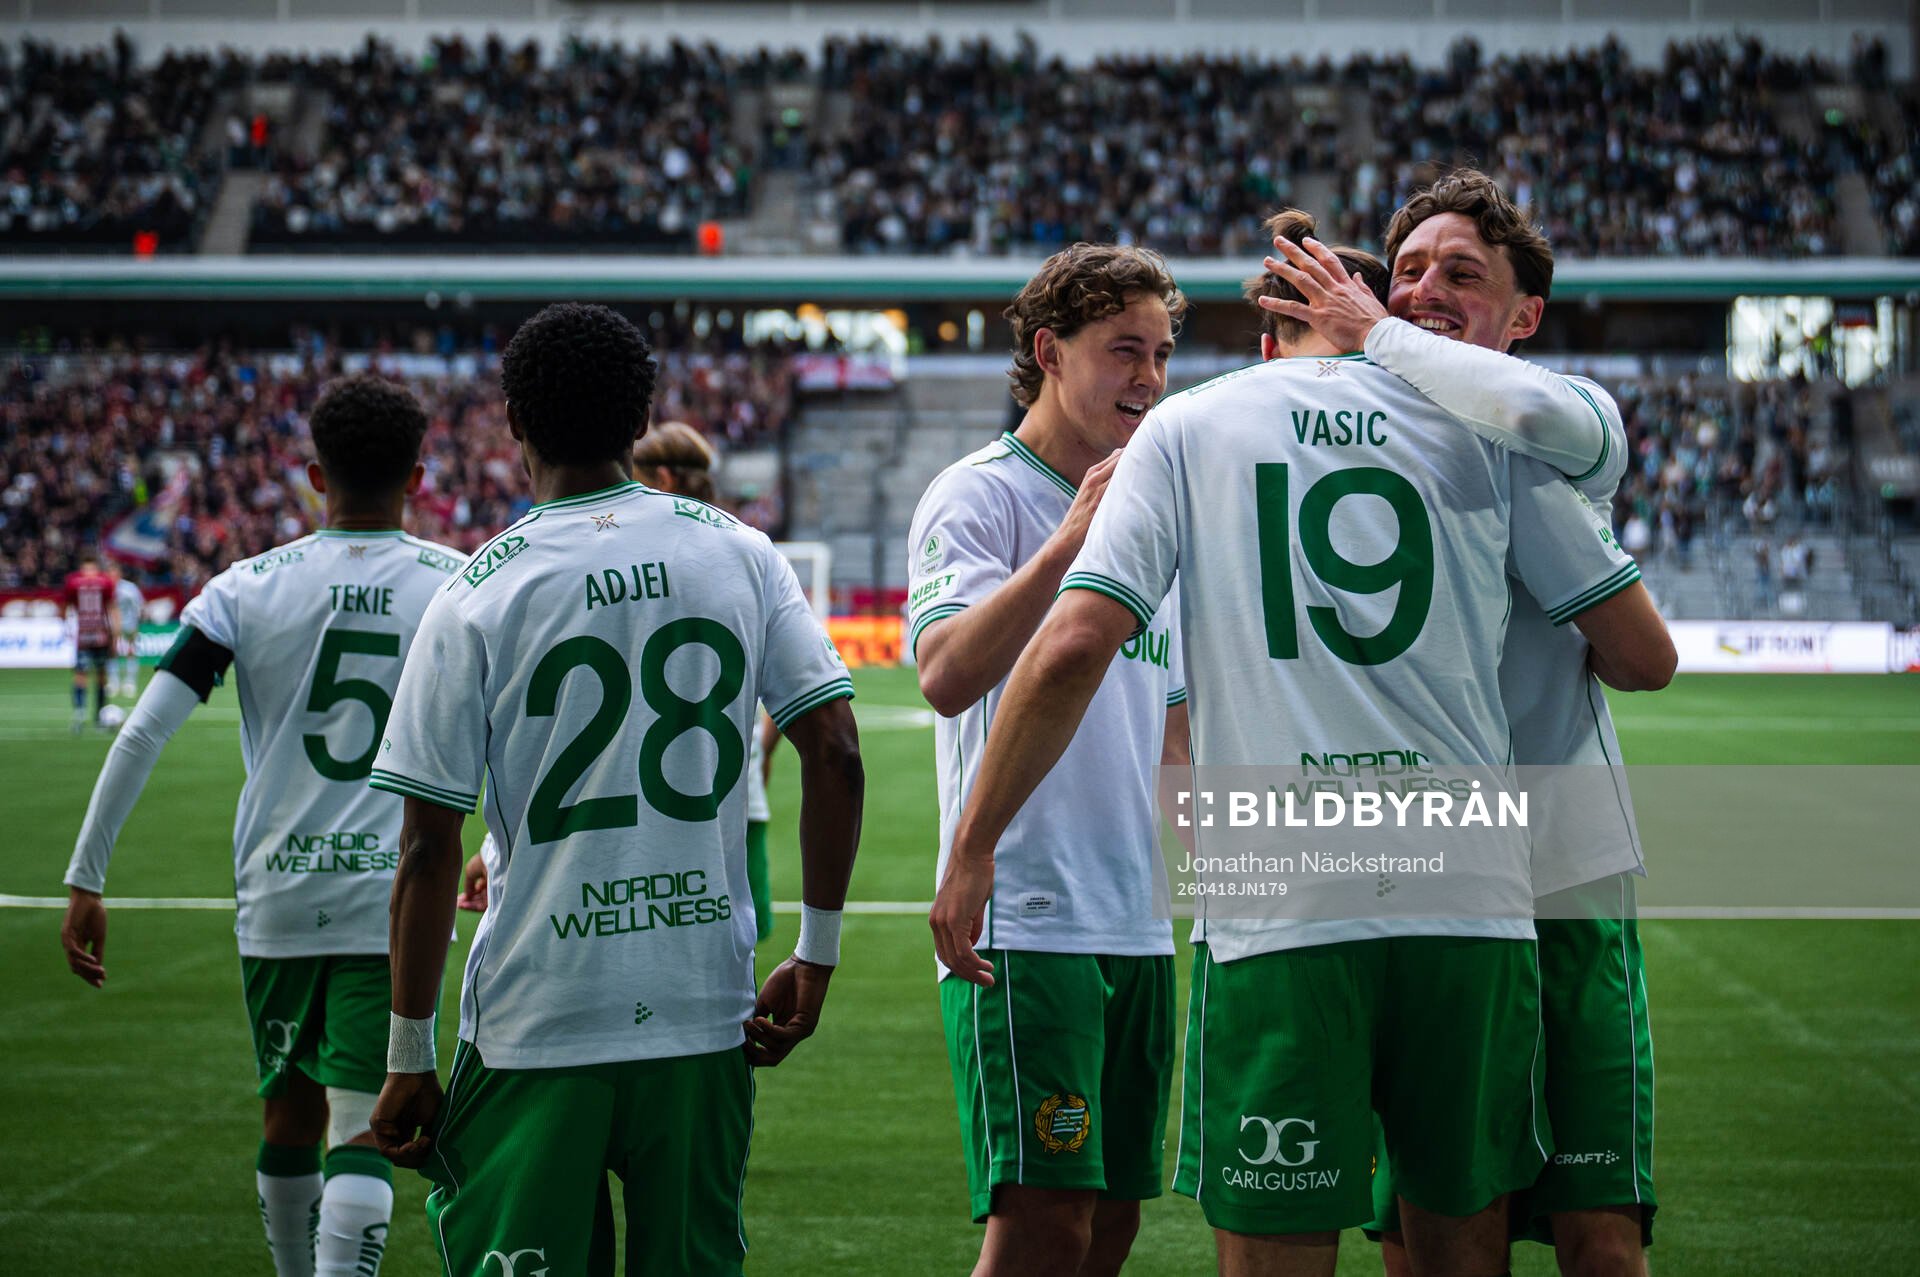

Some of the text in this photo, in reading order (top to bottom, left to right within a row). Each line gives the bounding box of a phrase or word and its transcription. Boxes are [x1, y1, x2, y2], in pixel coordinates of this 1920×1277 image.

[1291, 409, 1388, 447] VASIC
[462, 535, 525, 589] RYDS
[1255, 462, 1435, 666] 19
[329, 584, 394, 616] TEKIE
[585, 561, 670, 611] ADJEI
[911, 574, 956, 604] NIBET
[302, 629, 400, 782] 5
[525, 616, 747, 846] 28
[1300, 750, 1434, 778] NORDIC
[1268, 777, 1472, 809] WELLNESS
[287, 832, 380, 853] NORDIC
[265, 851, 400, 873] WELLNESS
[582, 869, 707, 908] NORDIC
[549, 894, 732, 939] WELLNESS
[1554, 1152, 1605, 1165] CRAFT
[1222, 1166, 1341, 1191] CARLGUSTAV
